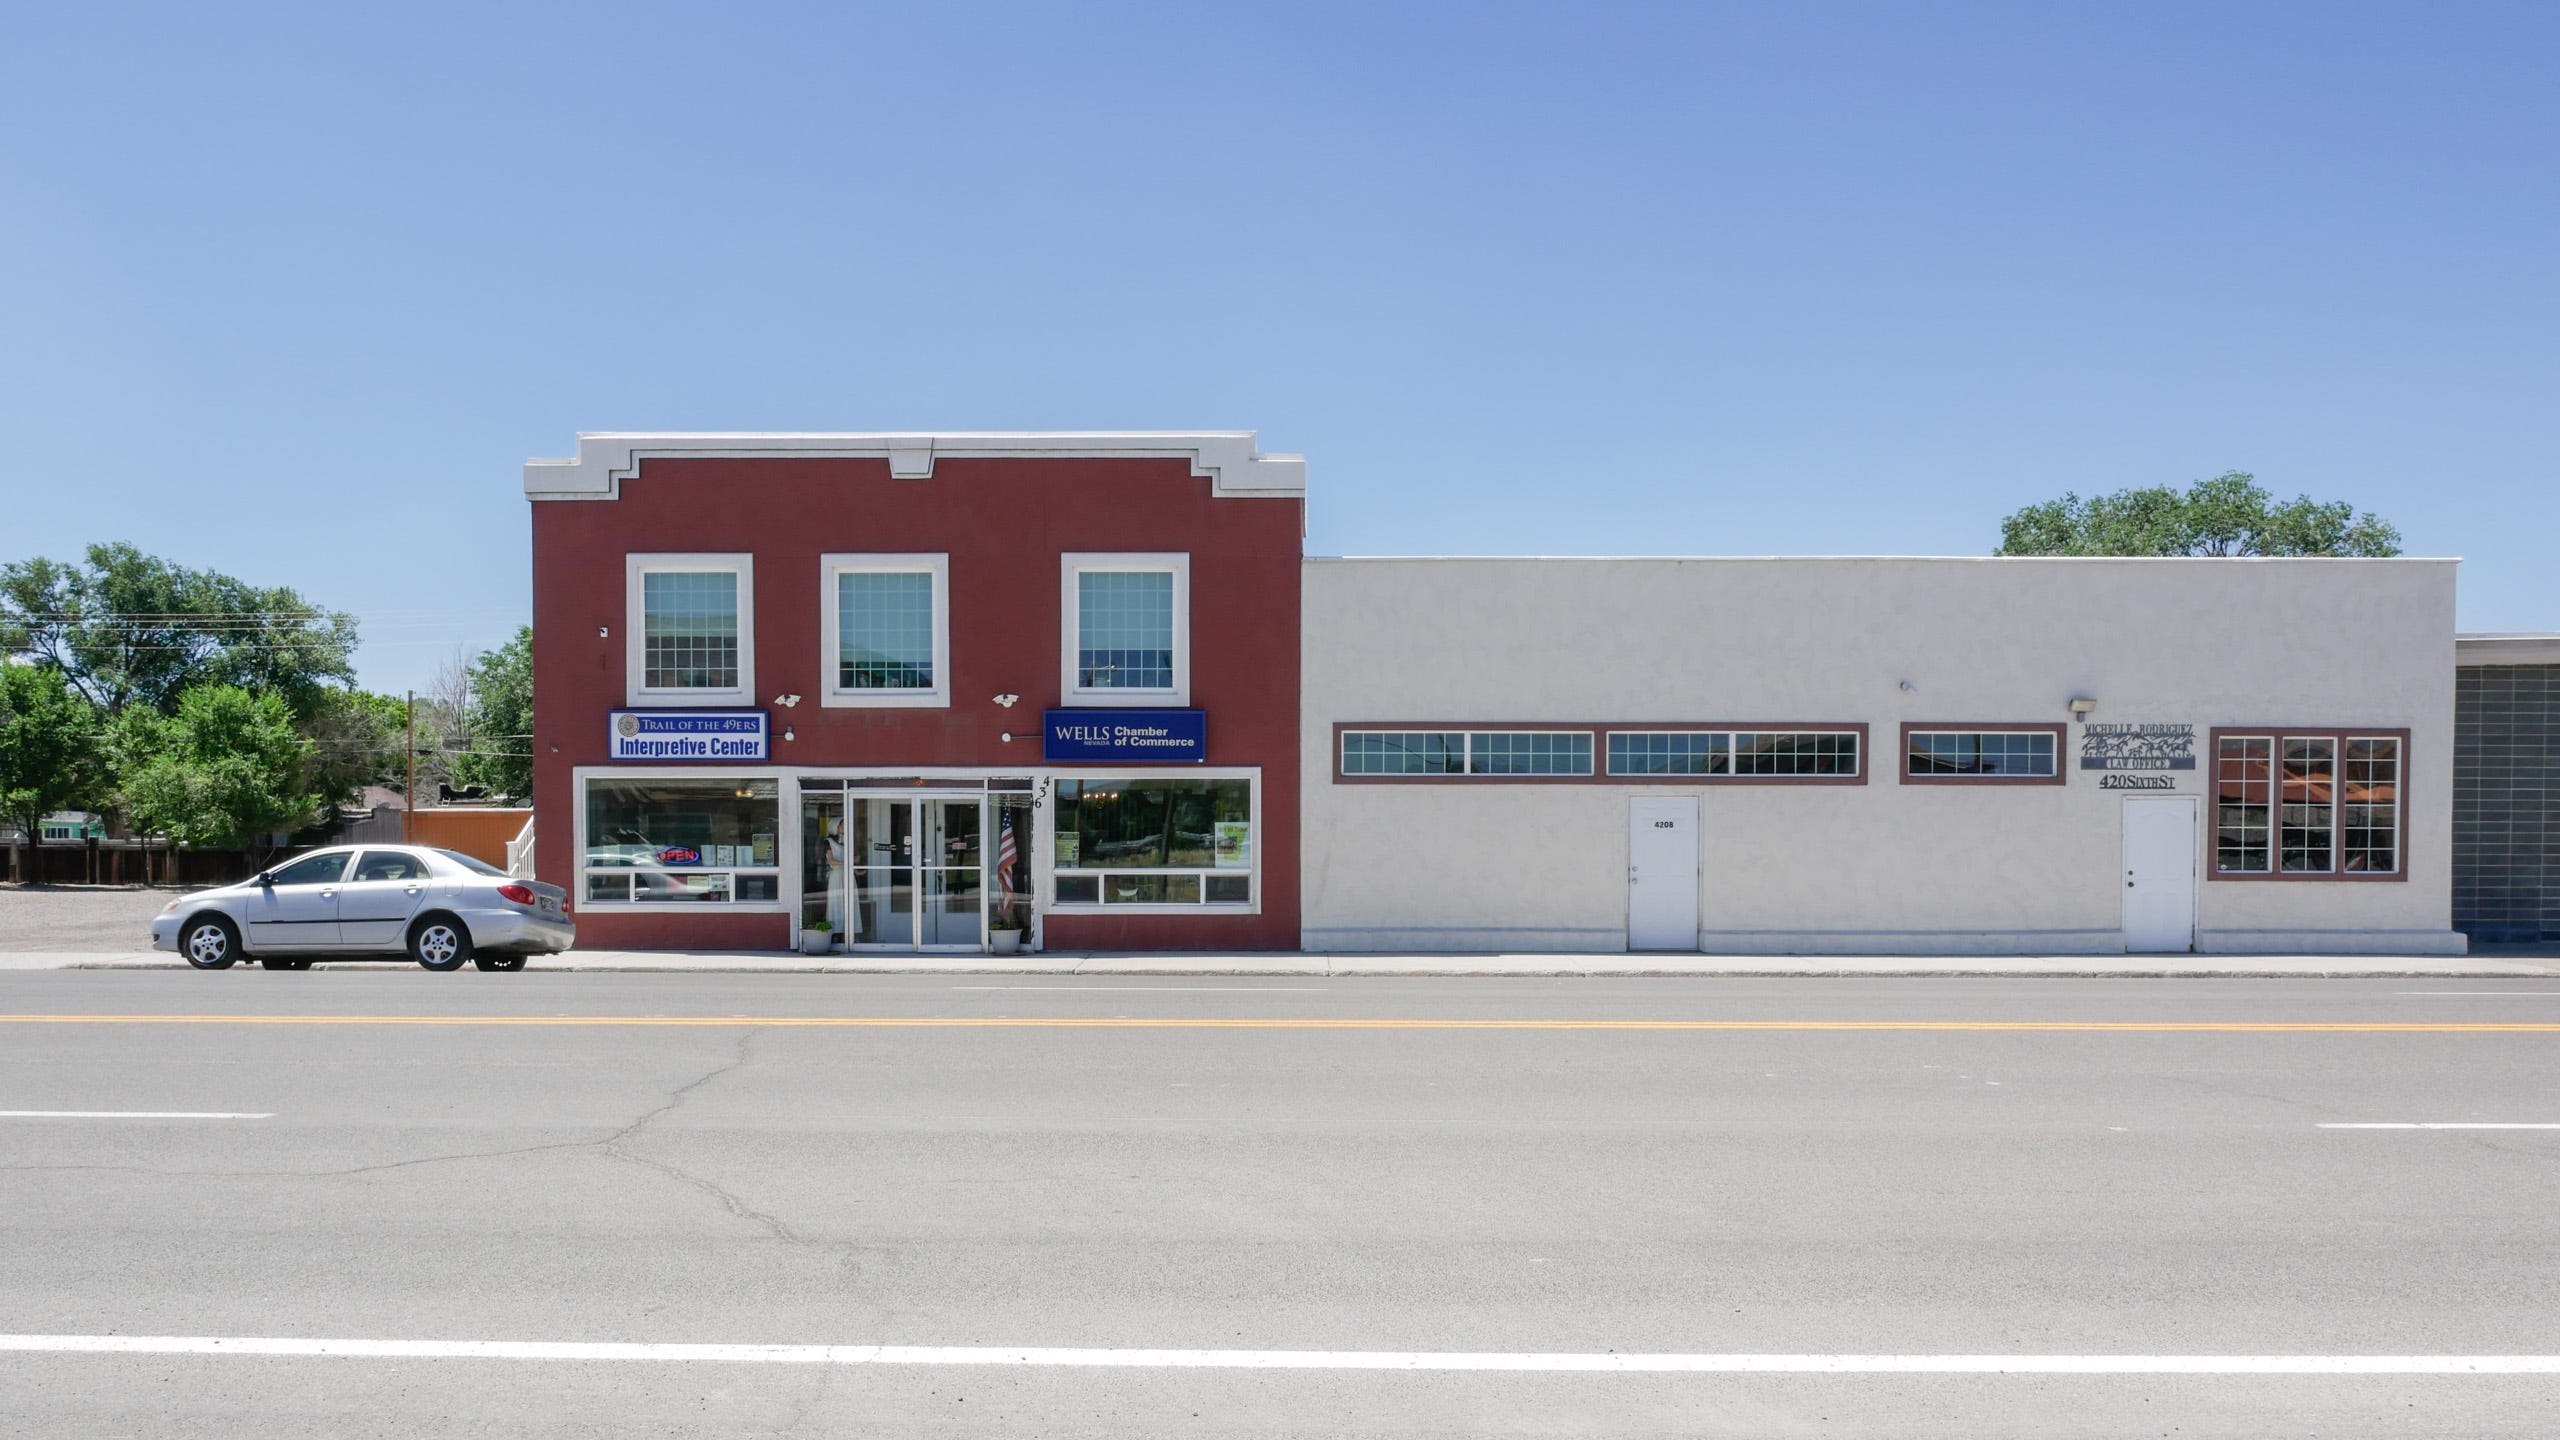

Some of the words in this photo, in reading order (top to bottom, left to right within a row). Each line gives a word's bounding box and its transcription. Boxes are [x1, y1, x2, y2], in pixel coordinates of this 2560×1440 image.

[641, 719, 675, 730] TRAIL
[678, 720, 694, 730] OF
[696, 720, 720, 730] THE
[722, 719, 757, 730] 49ERS
[2084, 723, 2132, 735] MICHELLE
[2139, 723, 2193, 735] RODRIGUEZ
[1055, 726, 1110, 740] WELLS
[1114, 726, 1168, 736] Chamber
[620, 737, 706, 757] Interpretive
[710, 737, 759, 755] Center
[1114, 736, 1127, 746] of
[1130, 736, 1195, 747] Commerce
[2109, 758, 2129, 769] LAW
[2132, 758, 2167, 769] OFFICE
[656, 850, 695, 861] OPEN
